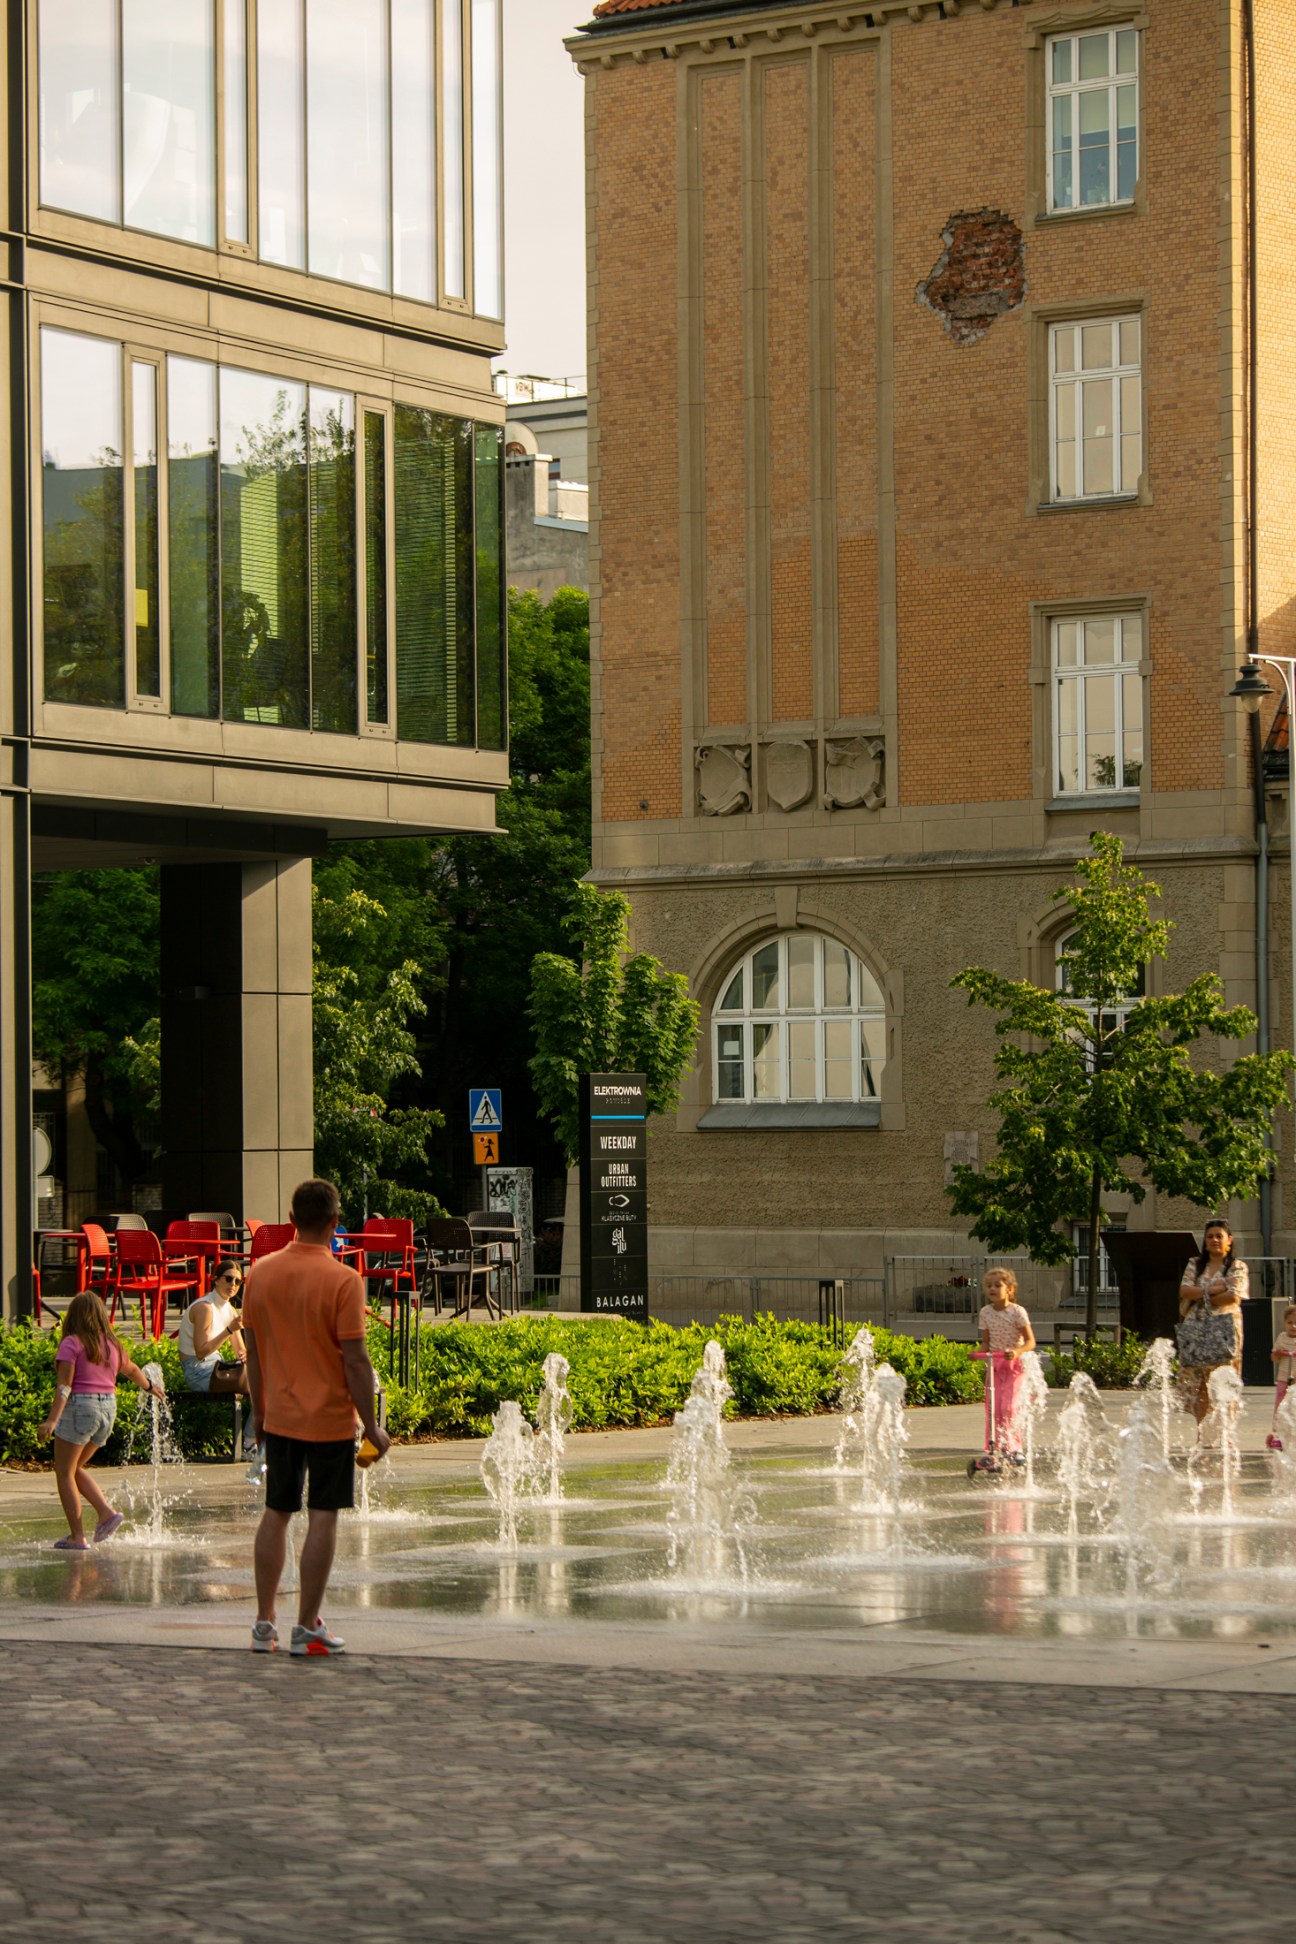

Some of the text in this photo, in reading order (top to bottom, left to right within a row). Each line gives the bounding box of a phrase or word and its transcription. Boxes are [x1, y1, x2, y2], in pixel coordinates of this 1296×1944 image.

[593, 1086, 642, 1095] ELEKTROWNIA
[600, 1136, 636, 1149] WEEKDAY
[608, 1163, 629, 1174] URBAN
[601, 1176, 637, 1187] OUTFITTERS
[596, 1295, 644, 1308] BALAGAN
